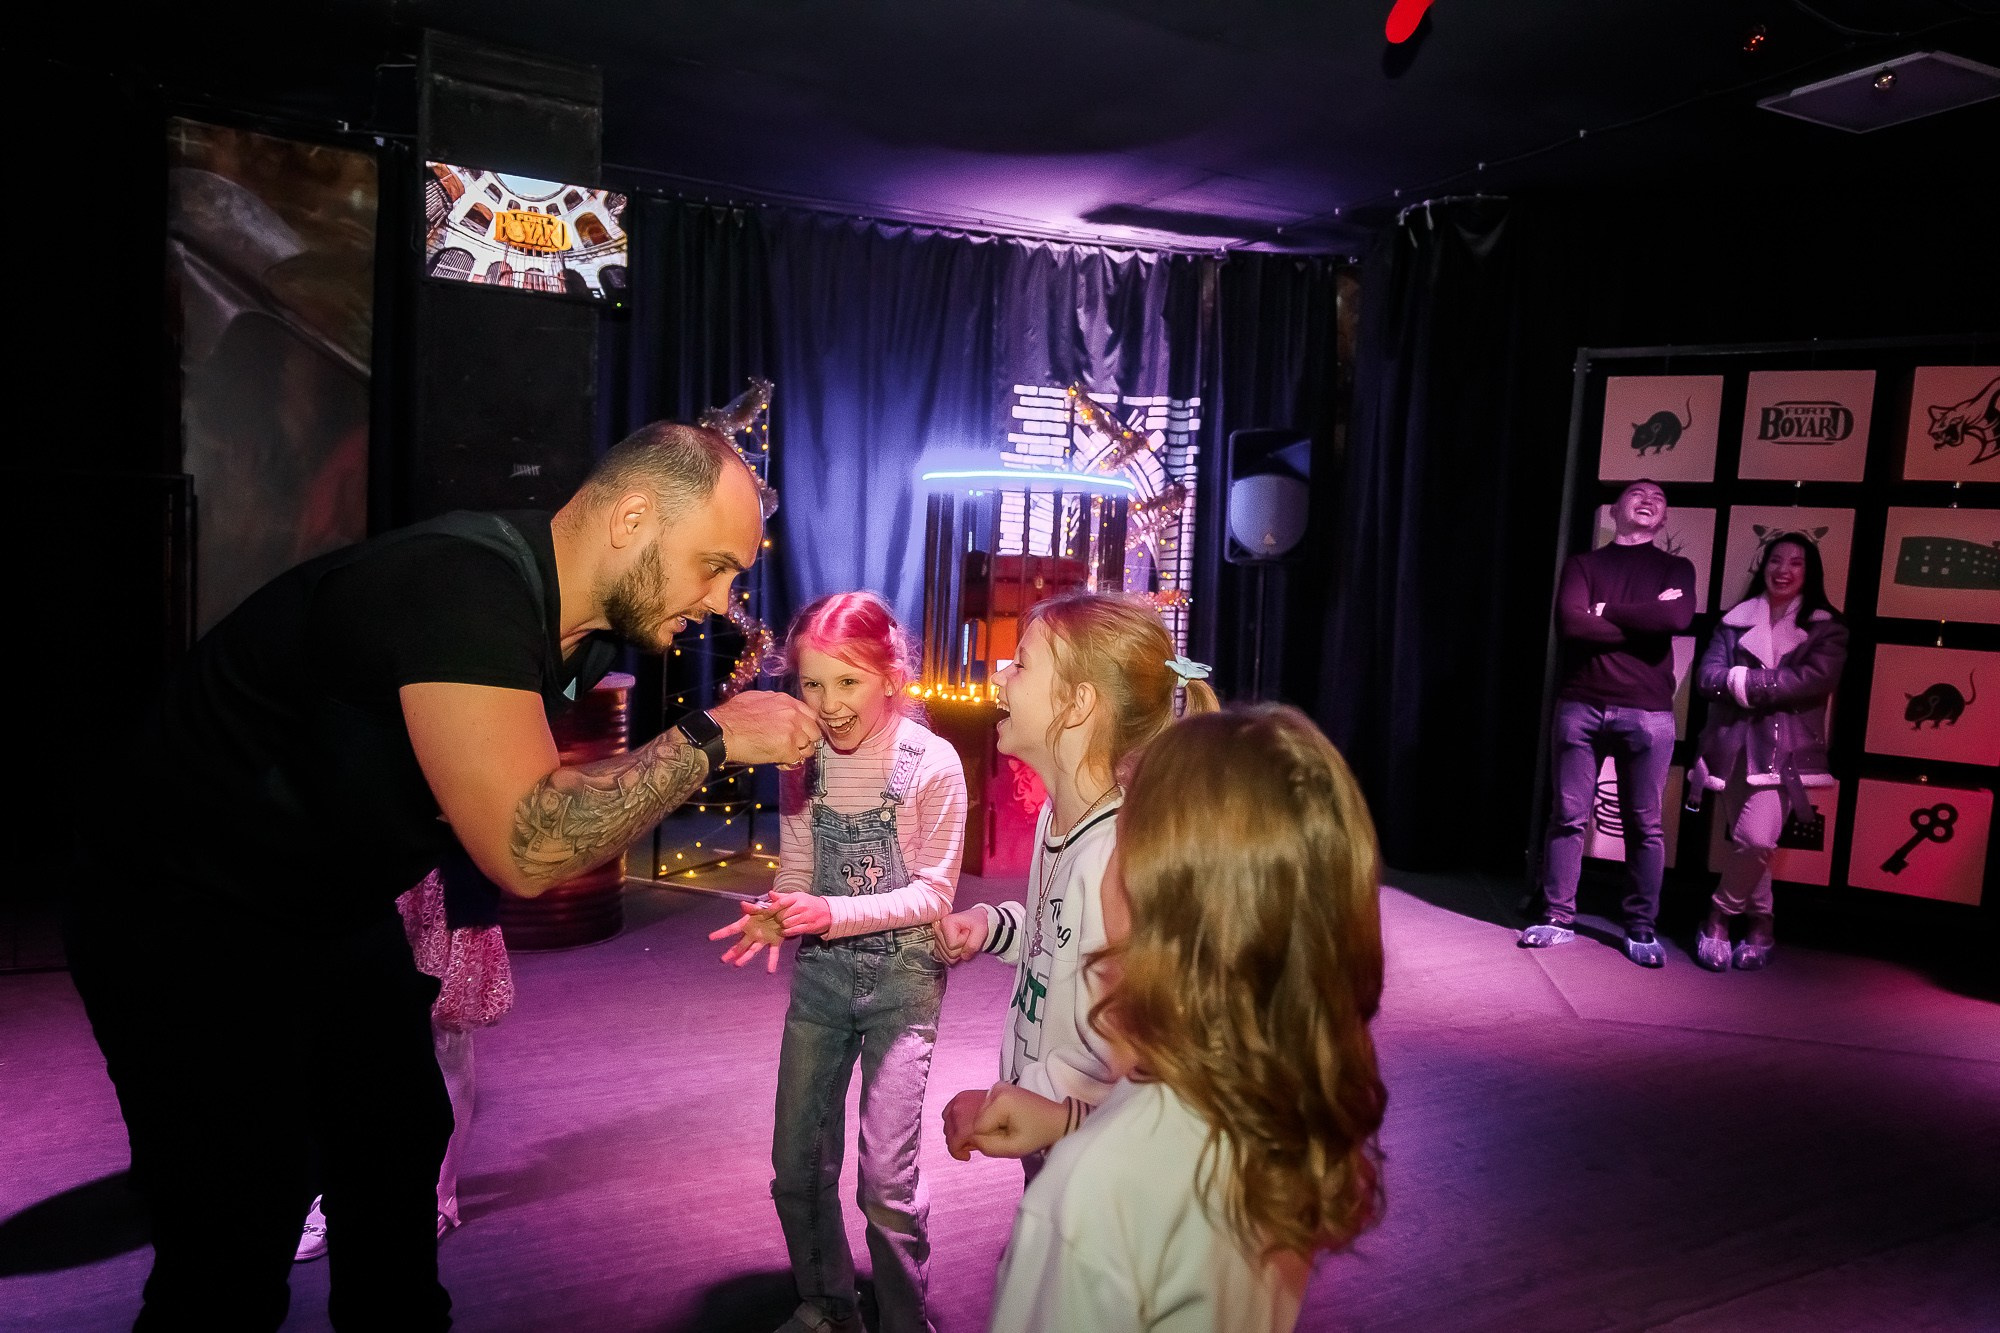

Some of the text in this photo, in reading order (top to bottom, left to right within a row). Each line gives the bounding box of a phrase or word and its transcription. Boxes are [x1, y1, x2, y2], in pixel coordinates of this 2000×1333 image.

[494, 211, 573, 251] BOYARD
[1758, 407, 1854, 440] BOYARD
[1785, 407, 1829, 415] FORT
